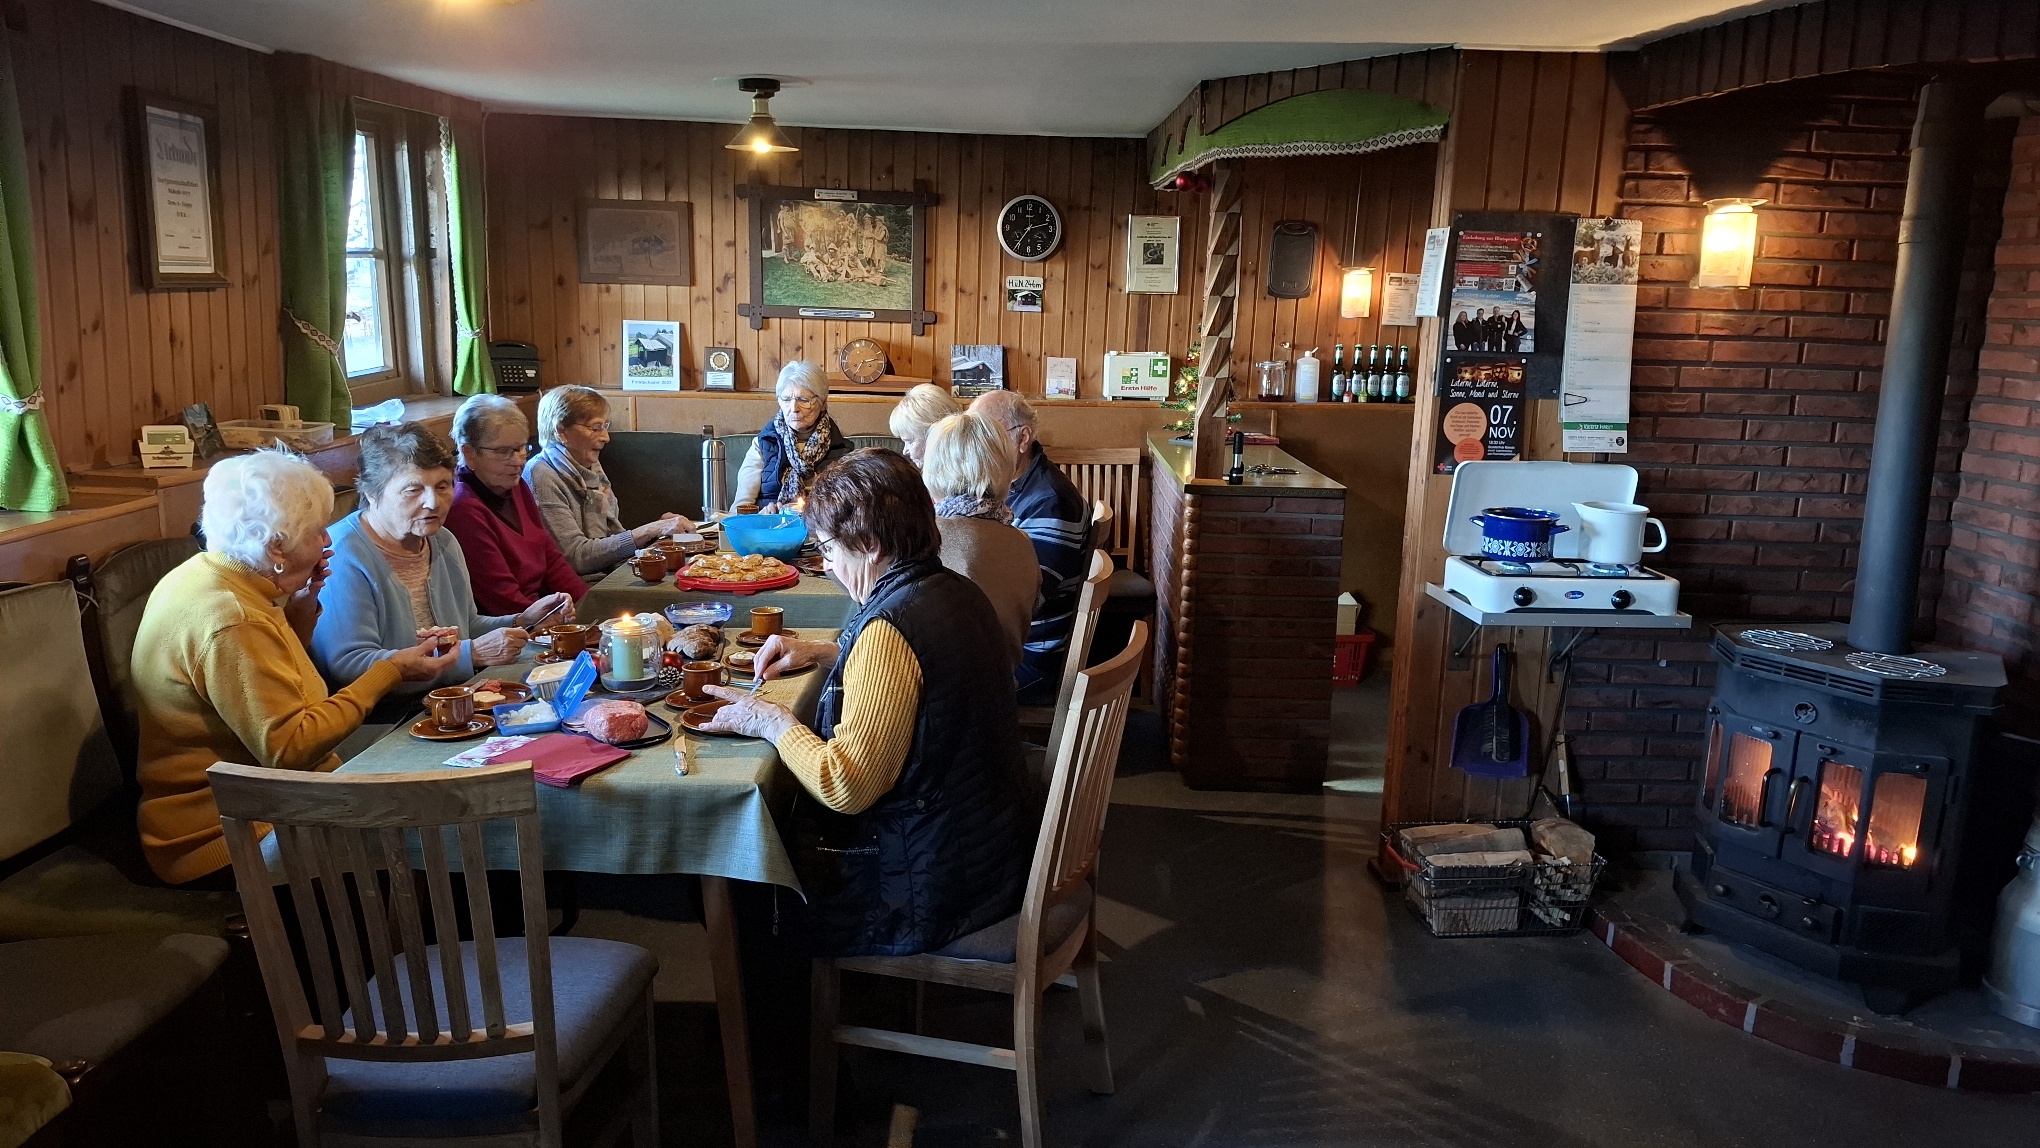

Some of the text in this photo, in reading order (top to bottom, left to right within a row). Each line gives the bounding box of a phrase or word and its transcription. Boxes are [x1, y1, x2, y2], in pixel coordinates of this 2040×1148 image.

[1017, 206, 1023, 214] 11
[1026, 203, 1033, 211] 12
[1009, 213, 1016, 221] 10
[1045, 213, 1050, 222] 2
[1048, 225, 1053, 233] 3
[1026, 245, 1031, 253] 6
[1036, 243, 1042, 251] 5
[1450, 379, 1473, 389] Laterne,
[1450, 389, 1519, 399] Sonne, Mond und Sterne
[1490, 405, 1516, 424] 07.
[1489, 427, 1515, 438] NOV
